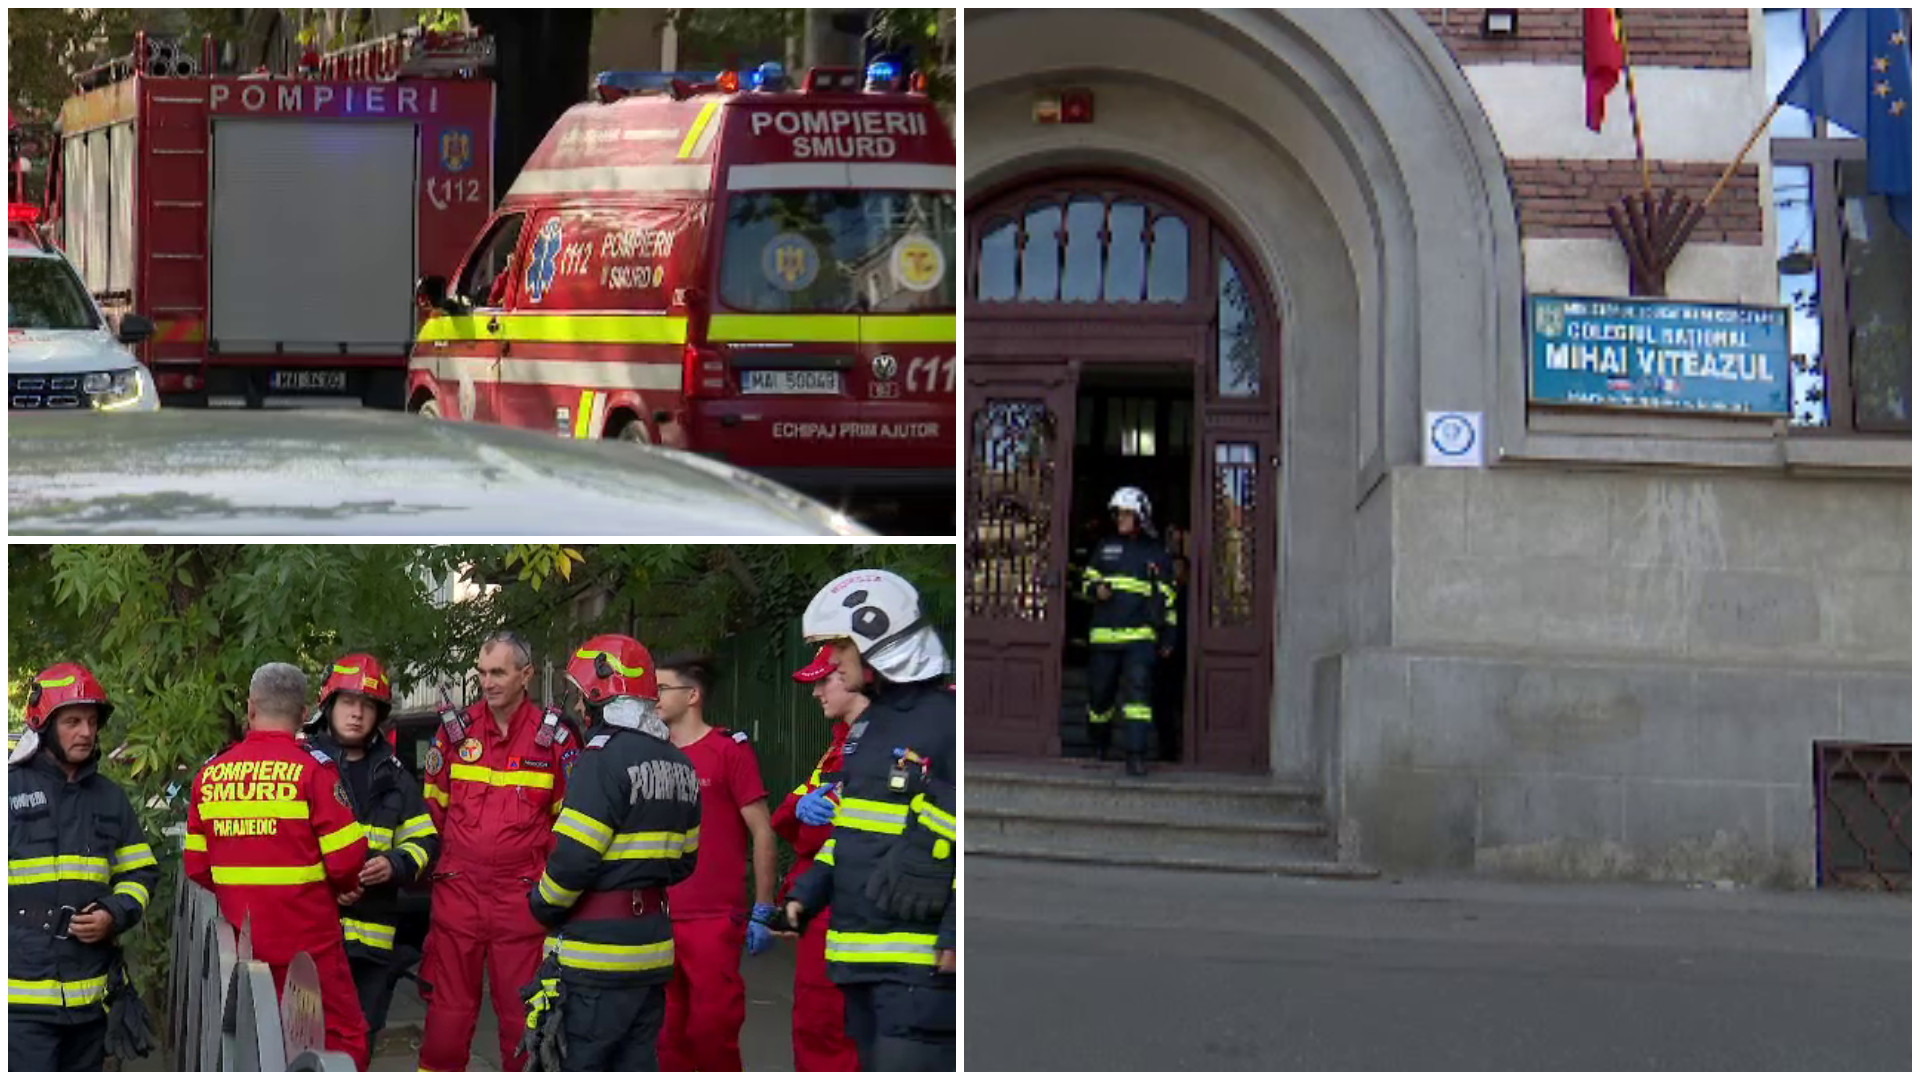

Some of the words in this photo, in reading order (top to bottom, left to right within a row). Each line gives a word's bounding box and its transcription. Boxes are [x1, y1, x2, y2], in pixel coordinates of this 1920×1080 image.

[210, 84, 437, 113] POMPIERI
[751, 110, 928, 136] POMPIERII
[792, 136, 896, 158] SMURD
[441, 179, 480, 202] 112
[1567, 321, 1658, 345] COLEGIUL
[1545, 341, 1629, 374] MIHAI
[1636, 345, 1774, 382] VITEAZUL
[772, 422, 836, 438] ECHIPAJ
[840, 422, 877, 438] PRIM
[881, 422, 939, 438] AJUTOR
[202, 761, 304, 784] POMPIERII
[201, 782, 298, 802] SMURD
[213, 819, 277, 837] PARAMEDIC
